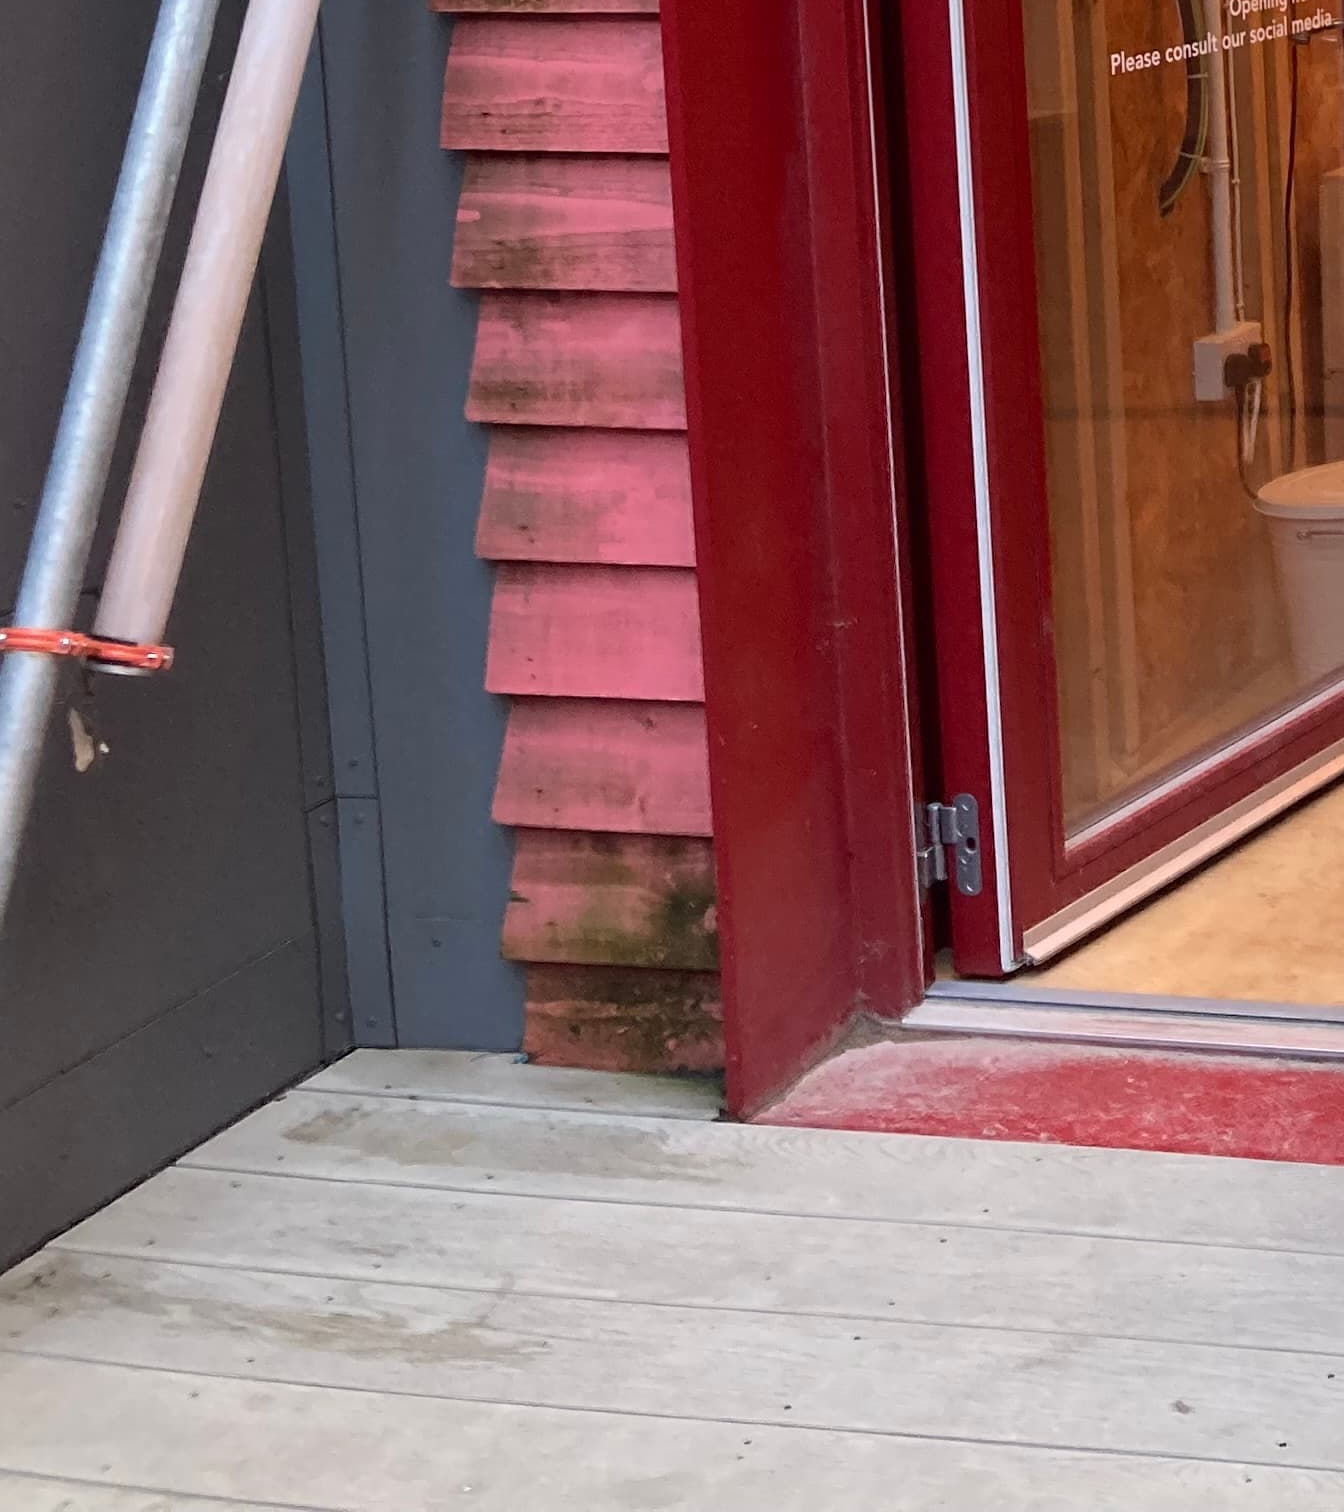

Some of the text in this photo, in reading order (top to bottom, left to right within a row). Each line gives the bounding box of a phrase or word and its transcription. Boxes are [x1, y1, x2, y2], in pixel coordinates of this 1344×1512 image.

[1111, 51, 1160, 76] Please
[1165, 31, 1218, 62] consult
[1222, 31, 1247, 49] our
[1249, 16, 1288, 44] social
